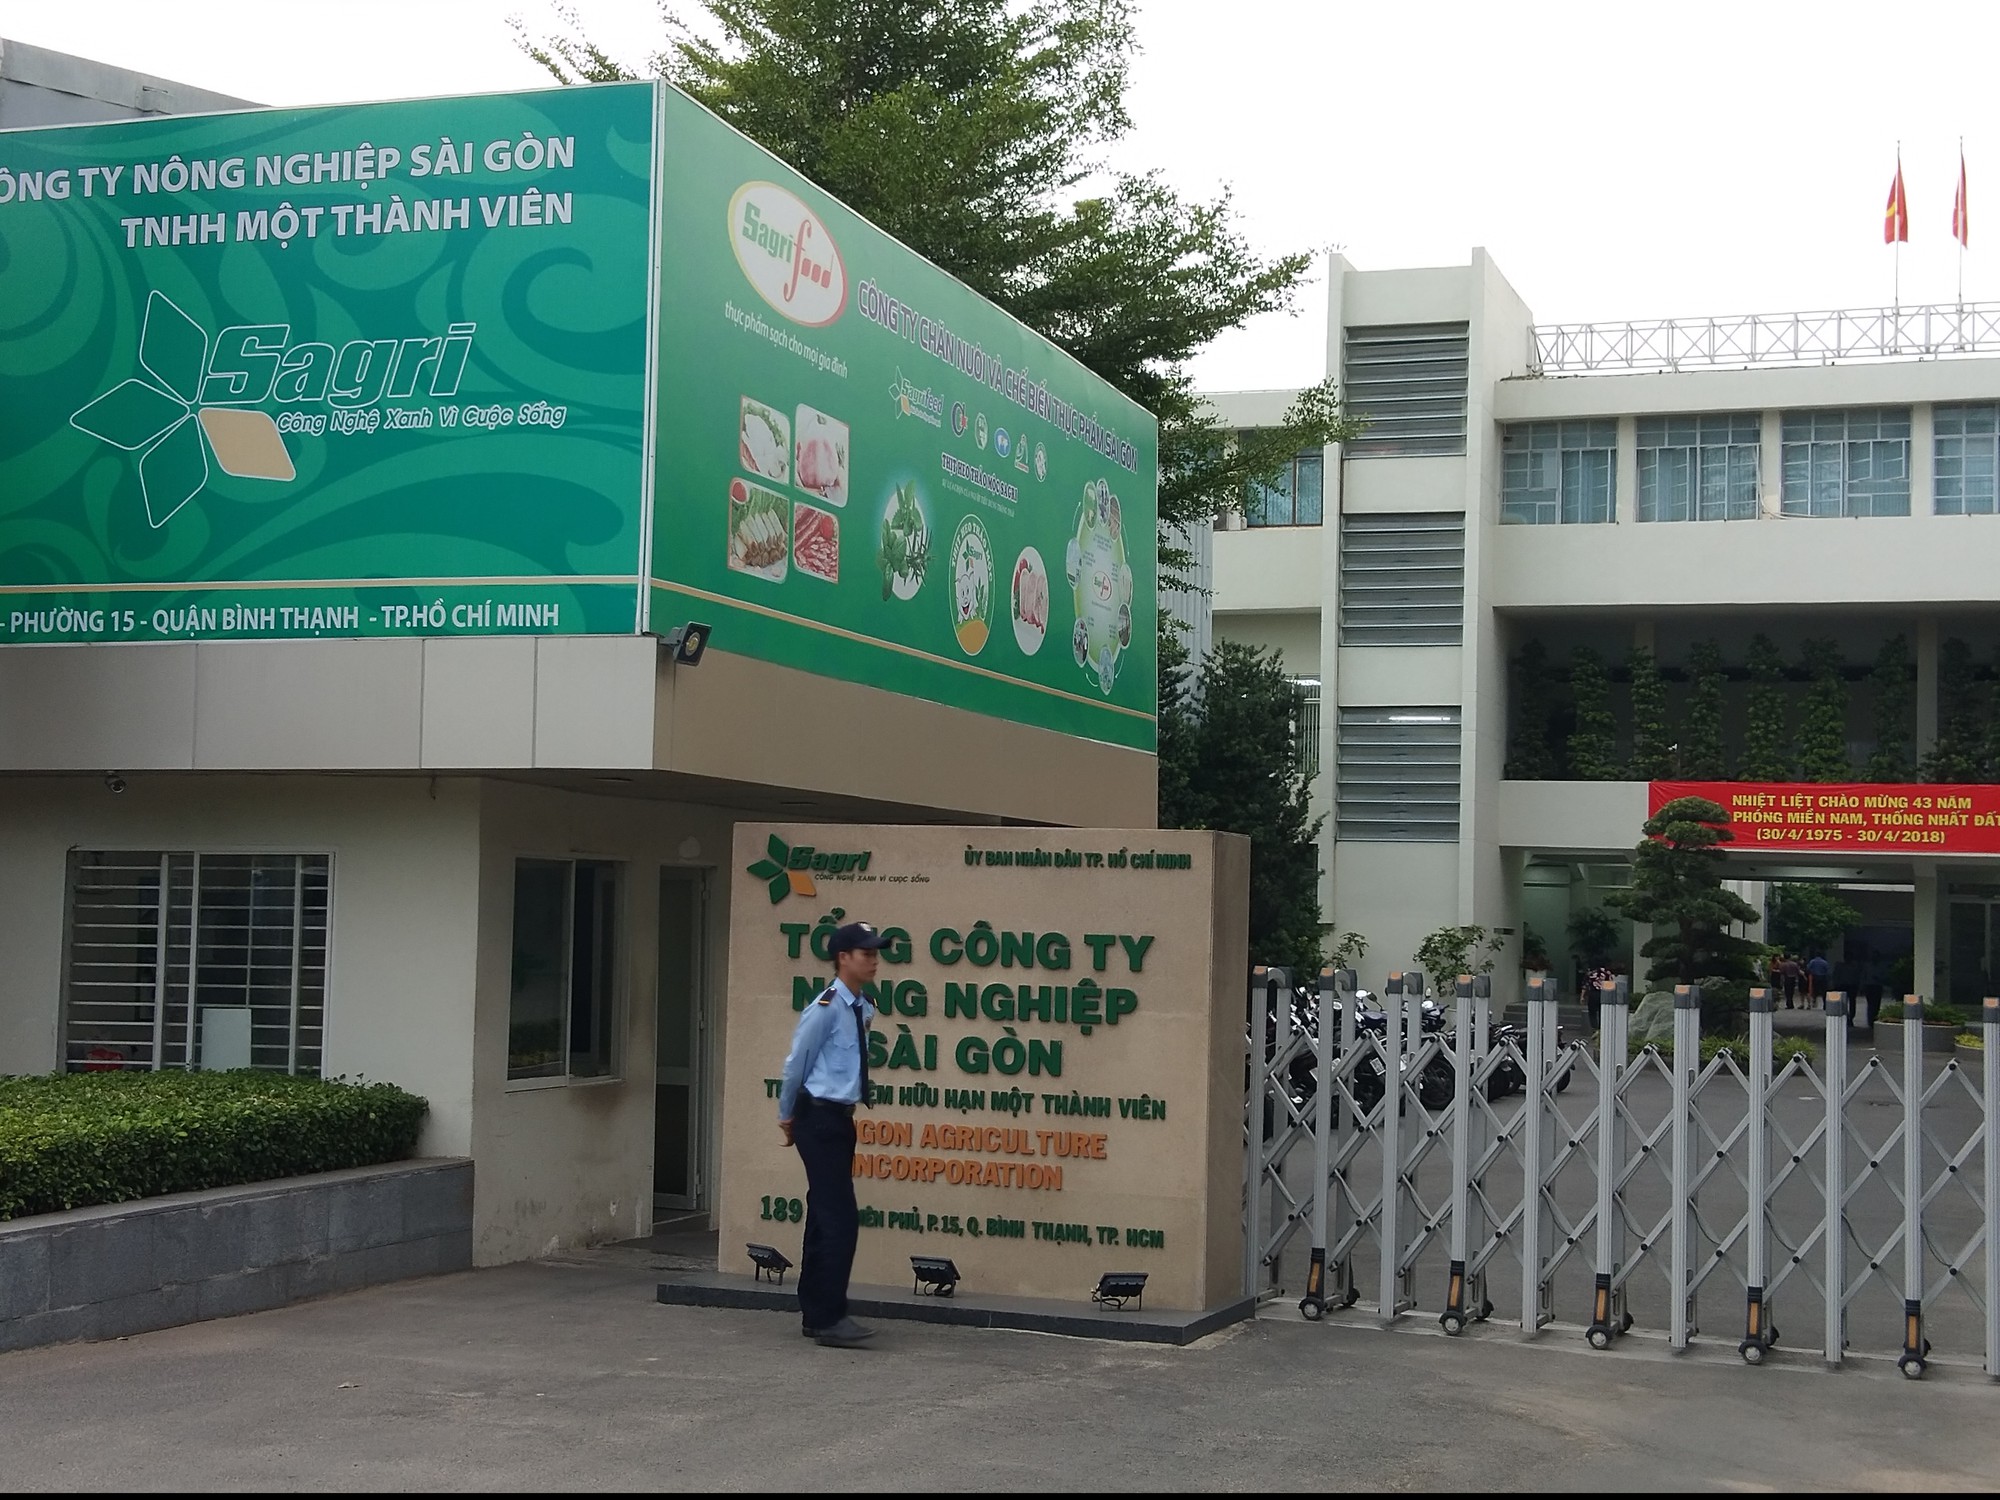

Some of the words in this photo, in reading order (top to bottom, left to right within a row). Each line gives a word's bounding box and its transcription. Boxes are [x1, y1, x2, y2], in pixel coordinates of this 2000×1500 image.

[78, 165, 124, 197] TY
[133, 155, 245, 194] NÔNG
[255, 142, 401, 190] NGHIỆP
[410, 136, 474, 177] SÀI
[483, 131, 575, 172] GÒN
[121, 212, 226, 248] TNHH
[236, 201, 324, 249] MỘT
[331, 195, 471, 237] THÀNH
[478, 187, 573, 228] VIÊN
[725, 300, 744, 327] thực
[744, 312, 769, 339] phẩm
[769, 329, 788, 348] sạch
[788, 334, 803, 356] cho
[803, 347, 819, 367] mọi
[818, 352, 831, 371] gia
[831, 356, 848, 378] đình
[199, 322, 477, 409] Sagri
[858, 277, 899, 334] CÔNG
[900, 303, 919, 343] TY
[956, 338, 986, 384] NUÔI
[987, 354, 1004, 395] VÀ
[1004, 366, 1028, 408] CHẾ
[1026, 379, 1052, 422] BIẾN
[1052, 400, 1079, 440] THỰC
[1078, 411, 1104, 455] PHẨM
[1104, 427, 1120, 464] SÀI
[1120, 437, 1139, 474] GÒN
[275, 412, 326, 437] Công
[330, 410, 380, 434] Nghệ
[383, 408, 432, 430] Xanh
[438, 405, 457, 427] Vì
[463, 406, 513, 430] Cuộc
[517, 400, 567, 428] Sống
[941, 452, 957, 477] THỊT
[957, 460, 971, 480] HEO
[10, 606, 104, 633] PHƯỜNG
[110, 610, 135, 632] 15
[152, 604, 216, 637] QUẬN
[222, 604, 275, 630] BÌNH
[280, 606, 358, 636] THẠNH
[452, 600, 492, 628] CHÍ
[497, 604, 559, 627] MINH
[1732, 793, 1776, 808] NHIỆT
[1781, 793, 1813, 809] LIỆT
[1819, 794, 1859, 807] CHÀO
[1864, 794, 1908, 808] MỪNG
[1912, 797, 1932, 808] 43
[1937, 795, 1971, 809] NĂM
[1733, 809, 1783, 823] PHÓNG
[1787, 808, 1825, 823] MIỀN
[1830, 813, 1867, 826] NAM,
[1872, 810, 1923, 825] THỐNG
[1928, 811, 1968, 826] NHẤT
[788, 846, 872, 873] Sagri
[964, 845, 983, 866] ỦY
[986, 850, 1013, 867] BAN
[1015, 848, 1052, 867] NHÂN
[1054, 848, 1082, 868] DÂN
[1085, 852, 1104, 868] TP.
[1107, 847, 1128, 869] HỒ
[1130, 849, 1159, 870] CHÍ
[1160, 853, 1192, 870] MINH
[814, 873, 834, 881] CÔNG
[780, 907, 912, 963] TỔG
[930, 920, 1071, 970] CÔNG
[1084, 934, 1155, 972] TY
[792, 976, 928, 1017] NNG
[944, 977, 1138, 1036] NGHIỆP
[868, 1023, 938, 1070] SÀI
[955, 1026, 1063, 1077] GÒN
[899, 1081, 938, 1107] HỮU
[945, 1088, 985, 1114] HẠN
[991, 1086, 1034, 1117] MỘT
[1042, 1090, 1111, 1118] THÀNH
[1118, 1093, 1166, 1120] VIÊN
[921, 1123, 1107, 1160] AGRICULTURE
[851, 1153, 1062, 1190] INCORPORATION
[761, 1195, 803, 1223] 189
[888, 1206, 924, 1233] PHỦ,
[967, 1216, 983, 1237] Q.
[986, 1215, 1025, 1238] BÌNH
[1033, 1221, 1092, 1246] THẠNH,
[1096, 1225, 1119, 1246] TP.
[1126, 1227, 1165, 1249] HCM
